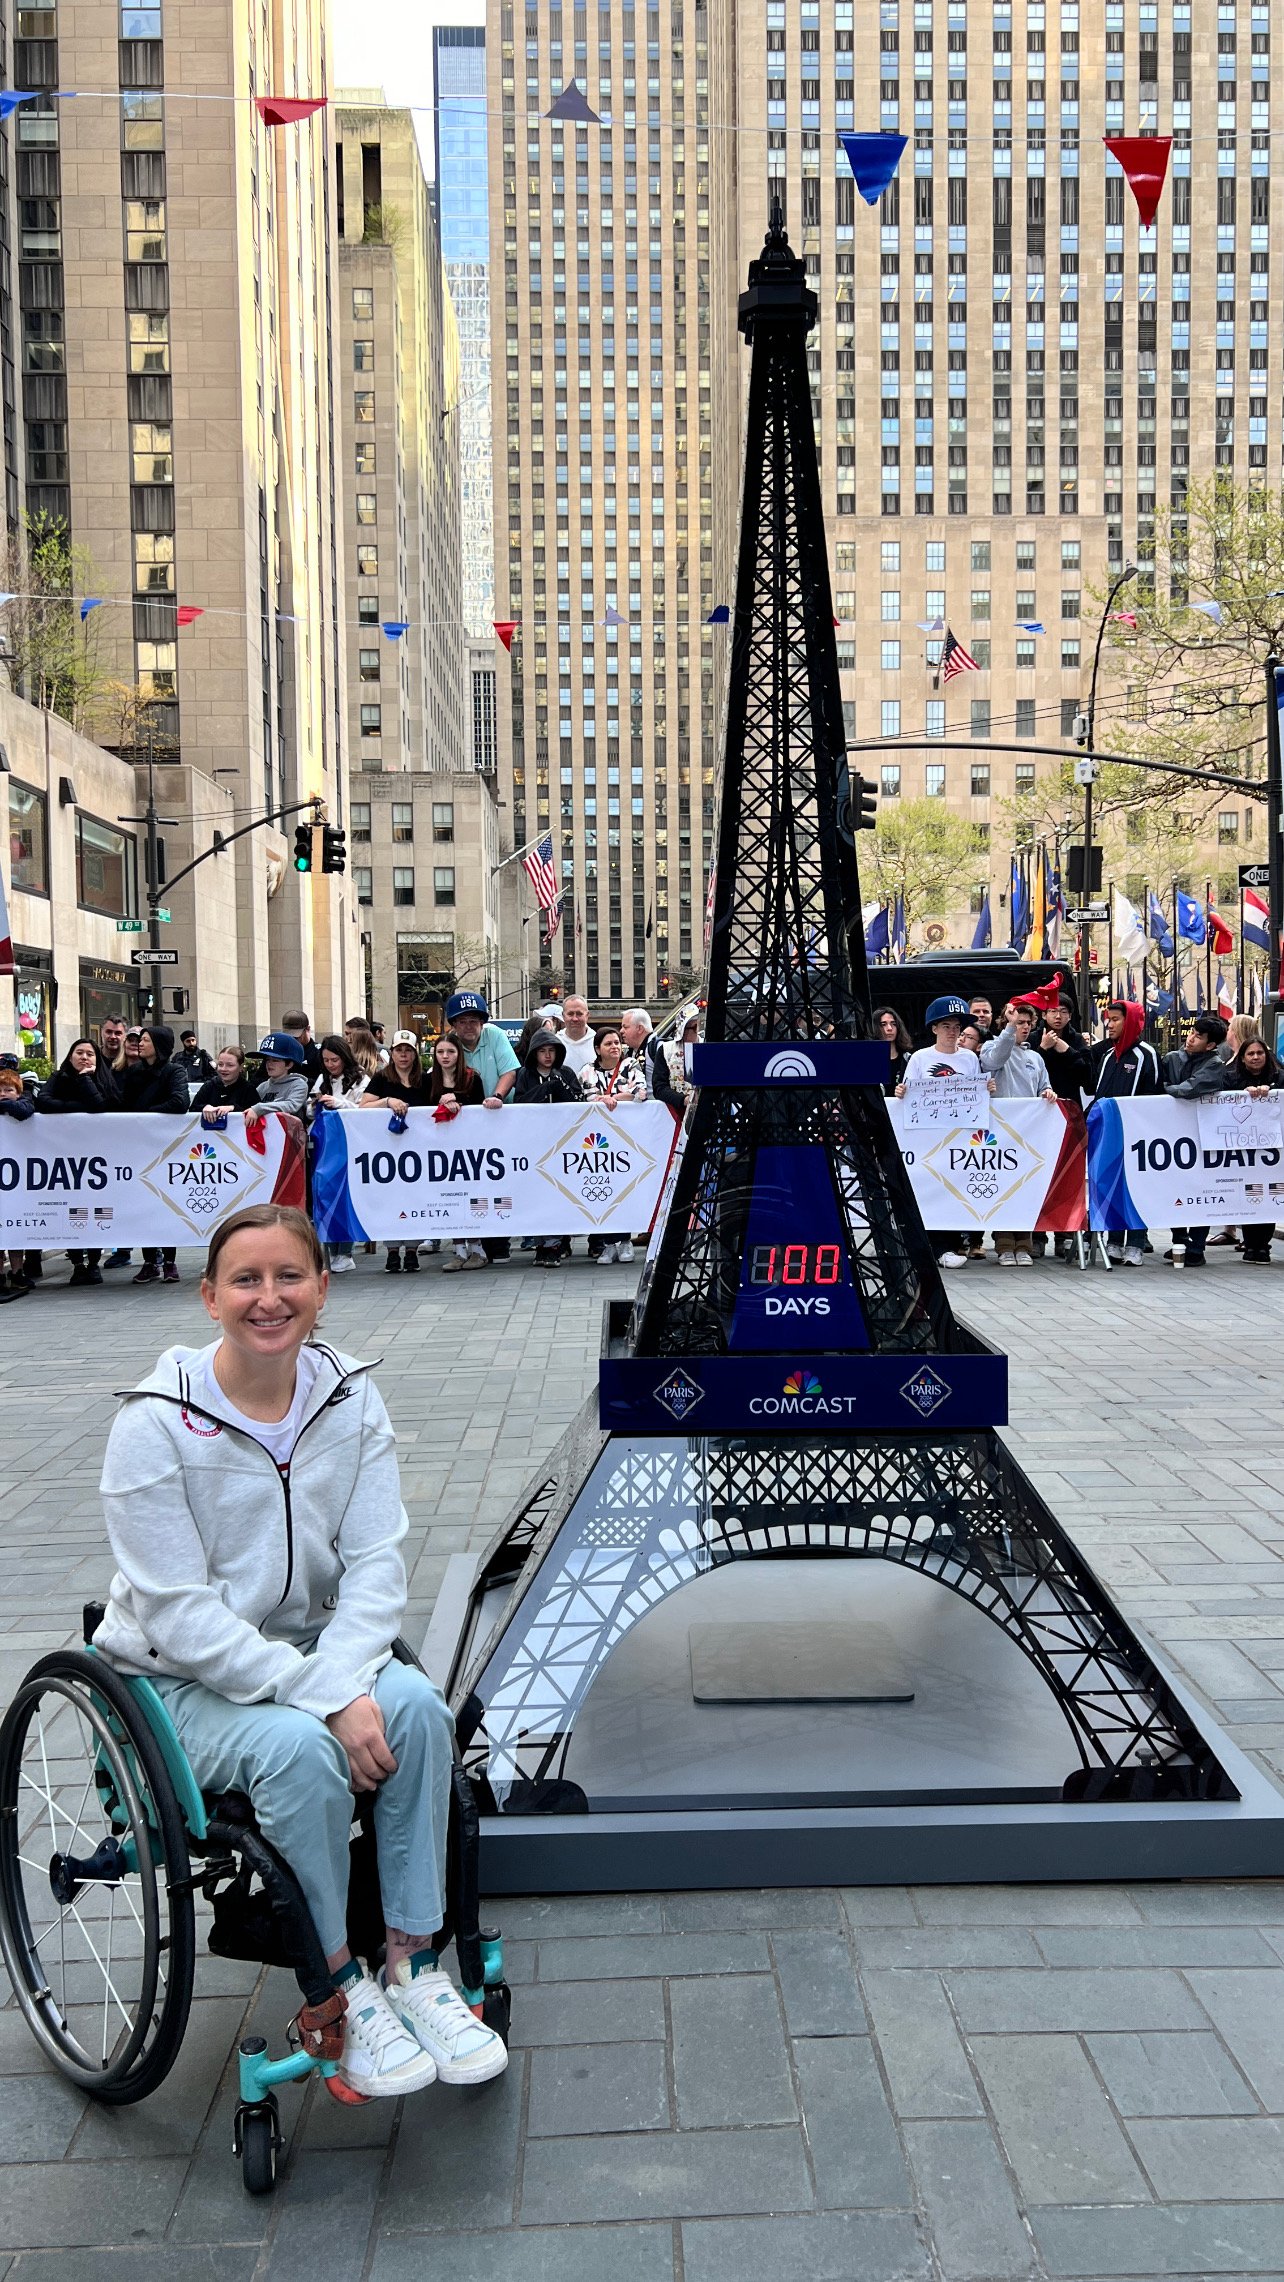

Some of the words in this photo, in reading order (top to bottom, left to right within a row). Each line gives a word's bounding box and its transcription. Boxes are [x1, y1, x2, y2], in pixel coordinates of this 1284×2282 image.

[1249, 871, 1268, 880] ONE
[118, 921, 124, 931] W
[125, 921, 133, 931] 49
[460, 1000, 477, 1009] USA
[948, 1004, 965, 1014] USA
[944, 1086, 977, 1097] performed
[1217, 1126, 1280, 1148] Today
[949, 1148, 1018, 1170] PARIS
[1131, 1136, 1197, 1172] 100
[1203, 1147, 1281, 1169] DAYS
[355, 1150, 422, 1184] 100
[428, 1148, 506, 1182] DAYS
[511, 1157, 529, 1171] TO
[562, 1151, 631, 1174] PARIS
[26, 1156, 107, 1191] DAYS
[114, 1166, 132, 1181] TO
[168, 1161, 239, 1185] PARIS
[969, 1172, 997, 1181] 2024
[583, 1175, 610, 1185] 2024
[188, 1186, 217, 1197] 2024
[1187, 1196, 1225, 1205] DELTA
[411, 1209, 449, 1218] DELTA
[6, 1219, 47, 1227] DELTA
[767, 1245, 840, 1285] 100
[765, 1297, 831, 1315] DAYS
[664, 1387, 695, 1398] PARIS
[911, 1384, 942, 1396] PARIS
[749, 1396, 857, 1414] COMCAST
